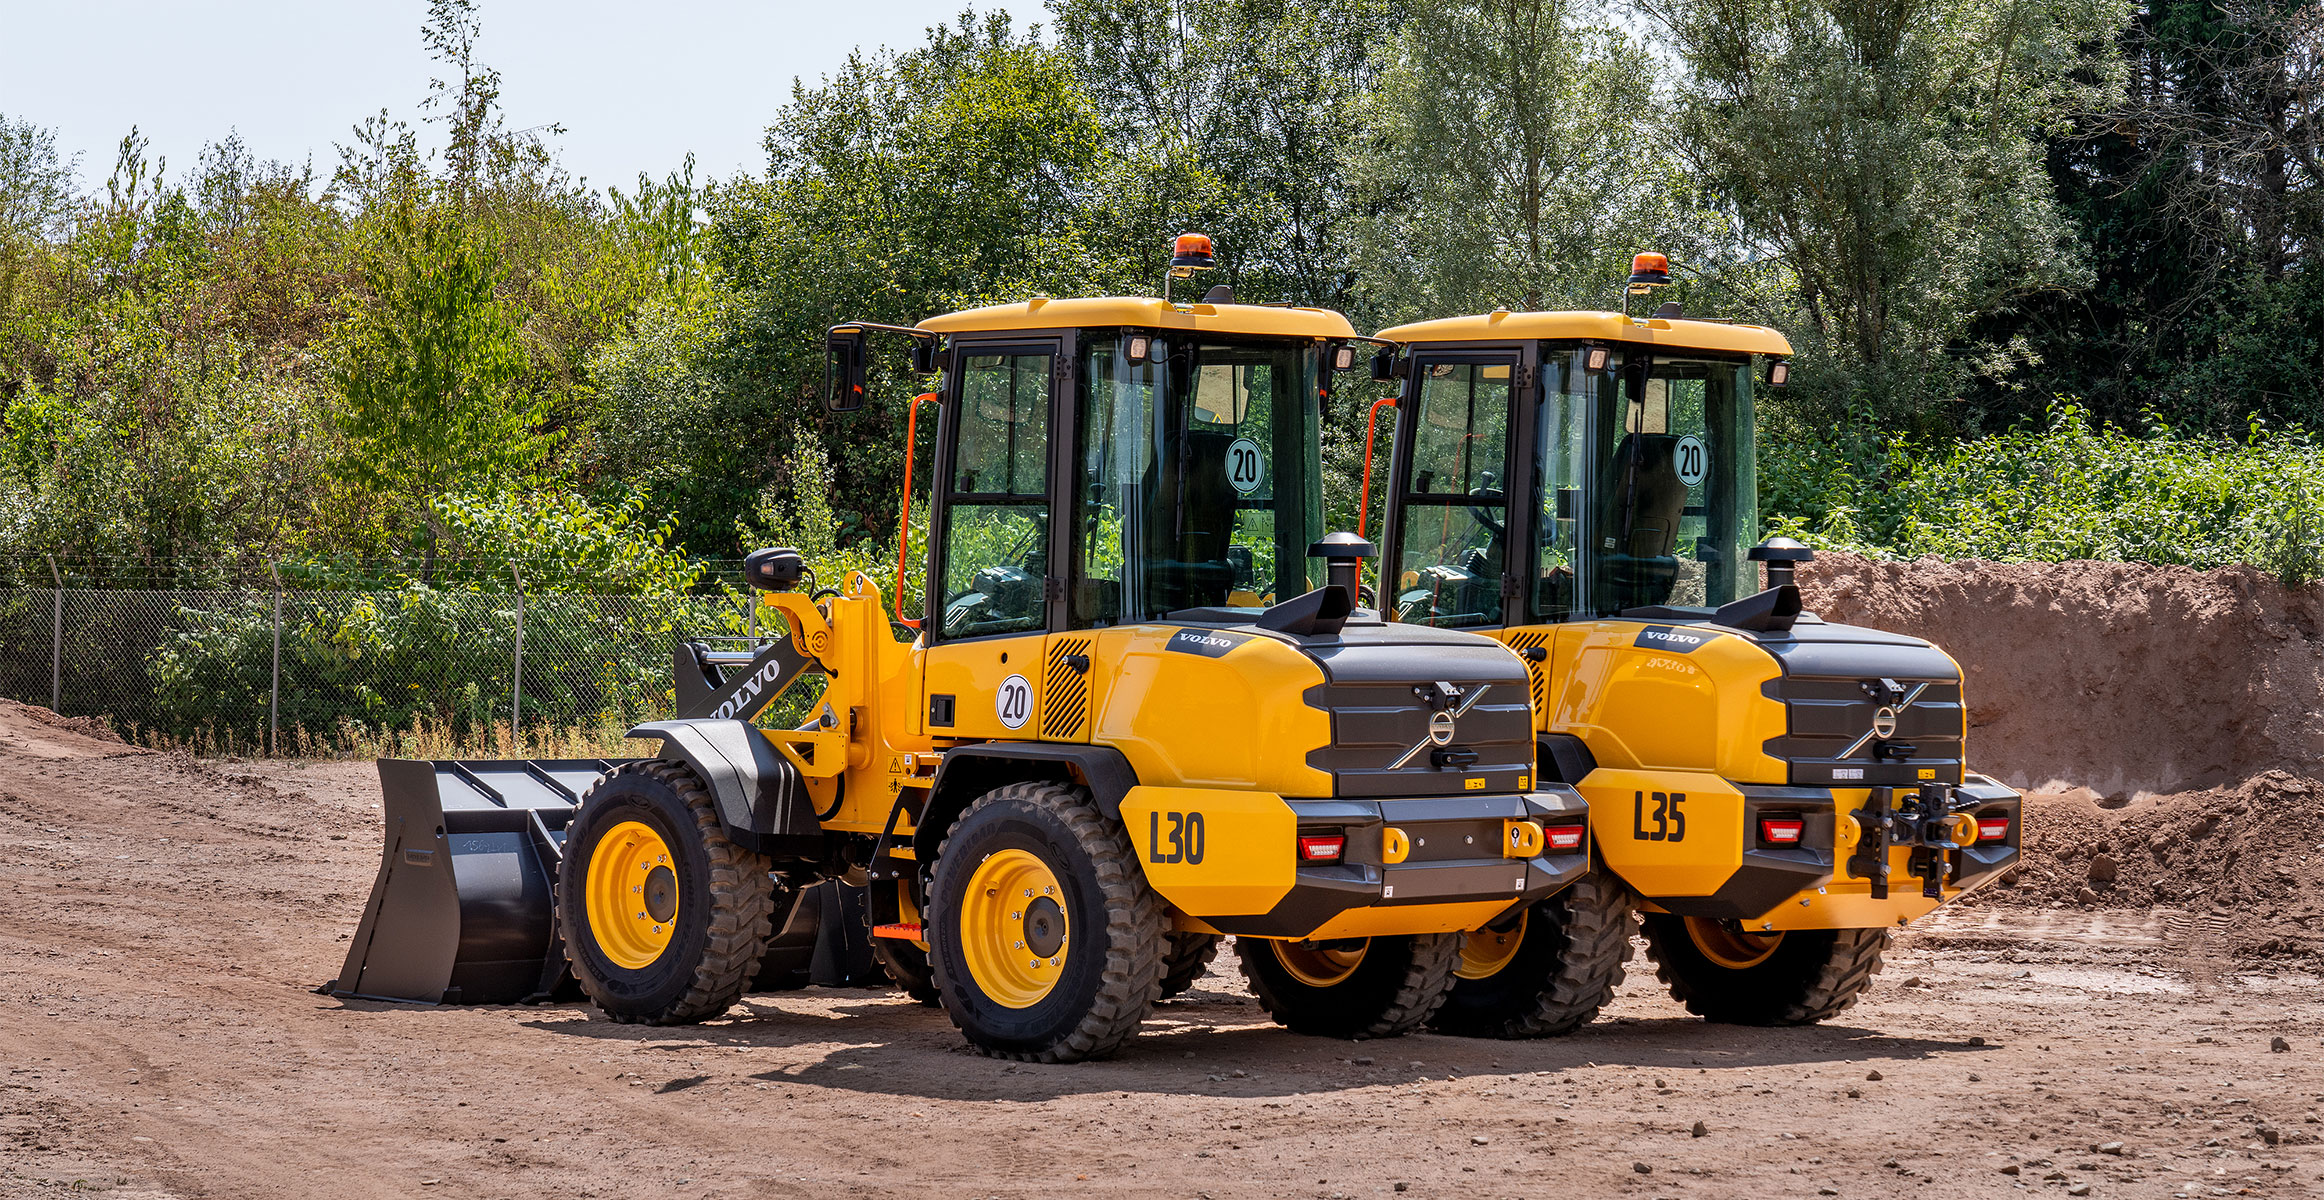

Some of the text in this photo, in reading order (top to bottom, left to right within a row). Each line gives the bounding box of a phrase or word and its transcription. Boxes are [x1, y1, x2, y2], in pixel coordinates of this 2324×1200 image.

[1233, 448, 1257, 484] 20
[1680, 444, 1701, 478] 20
[1180, 633, 1232, 648] VOLVO
[1646, 631, 1701, 645] VOLVO
[1002, 684, 1026, 720] 20
[1633, 790, 1687, 843] L35
[1149, 811, 1205, 866] L30
